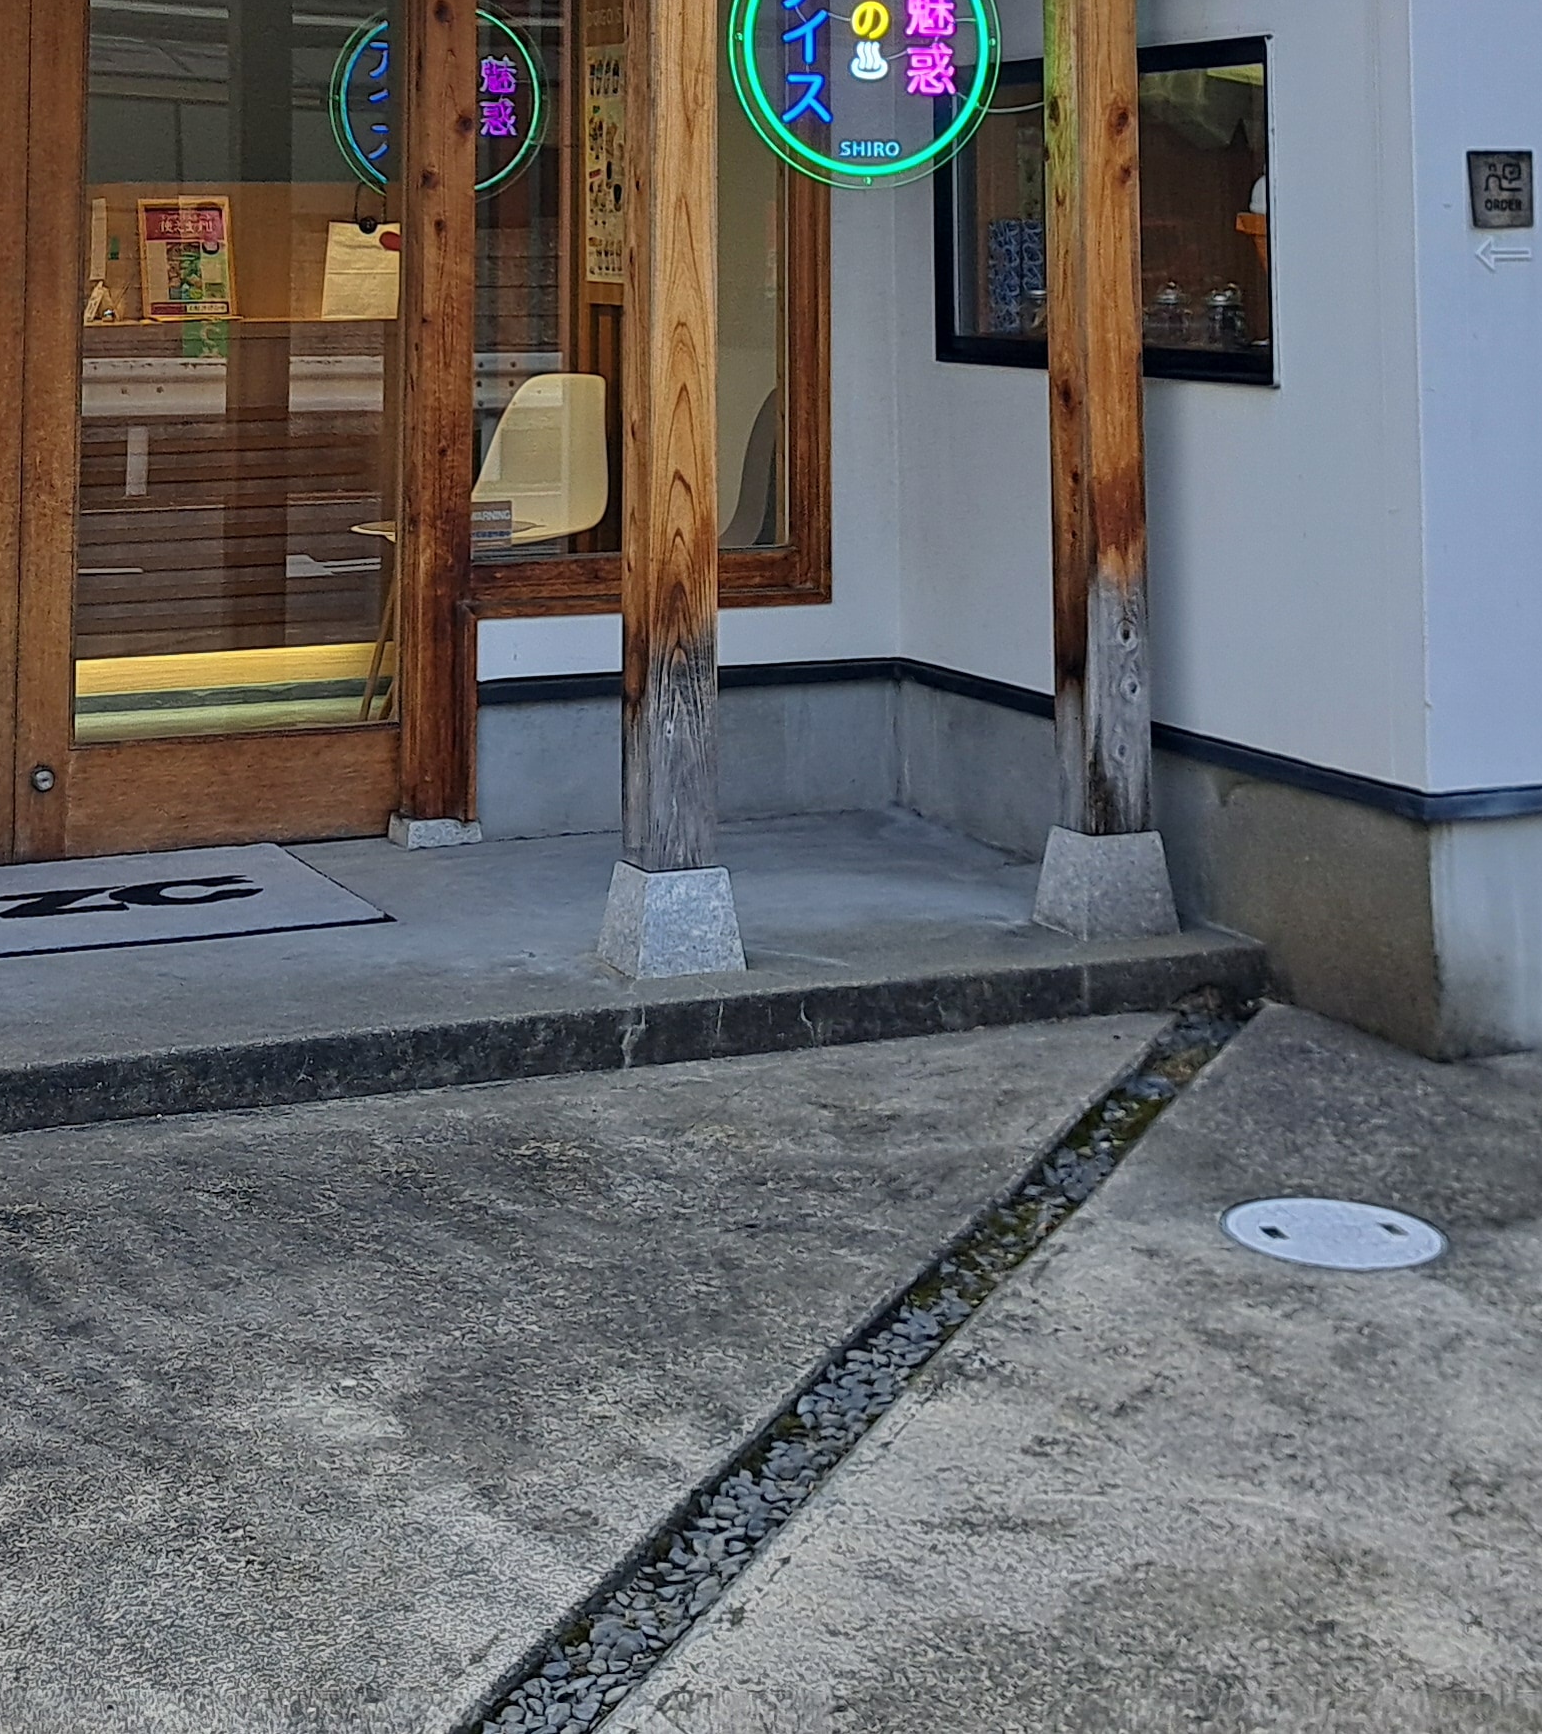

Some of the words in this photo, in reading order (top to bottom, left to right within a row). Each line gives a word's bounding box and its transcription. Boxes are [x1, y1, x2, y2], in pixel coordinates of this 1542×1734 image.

[851, 0, 889, 40] の
[479, 55, 517, 137] 魅惑
[839, 141, 900, 158] SHIRO
[1484, 198, 1523, 213] ORDER
